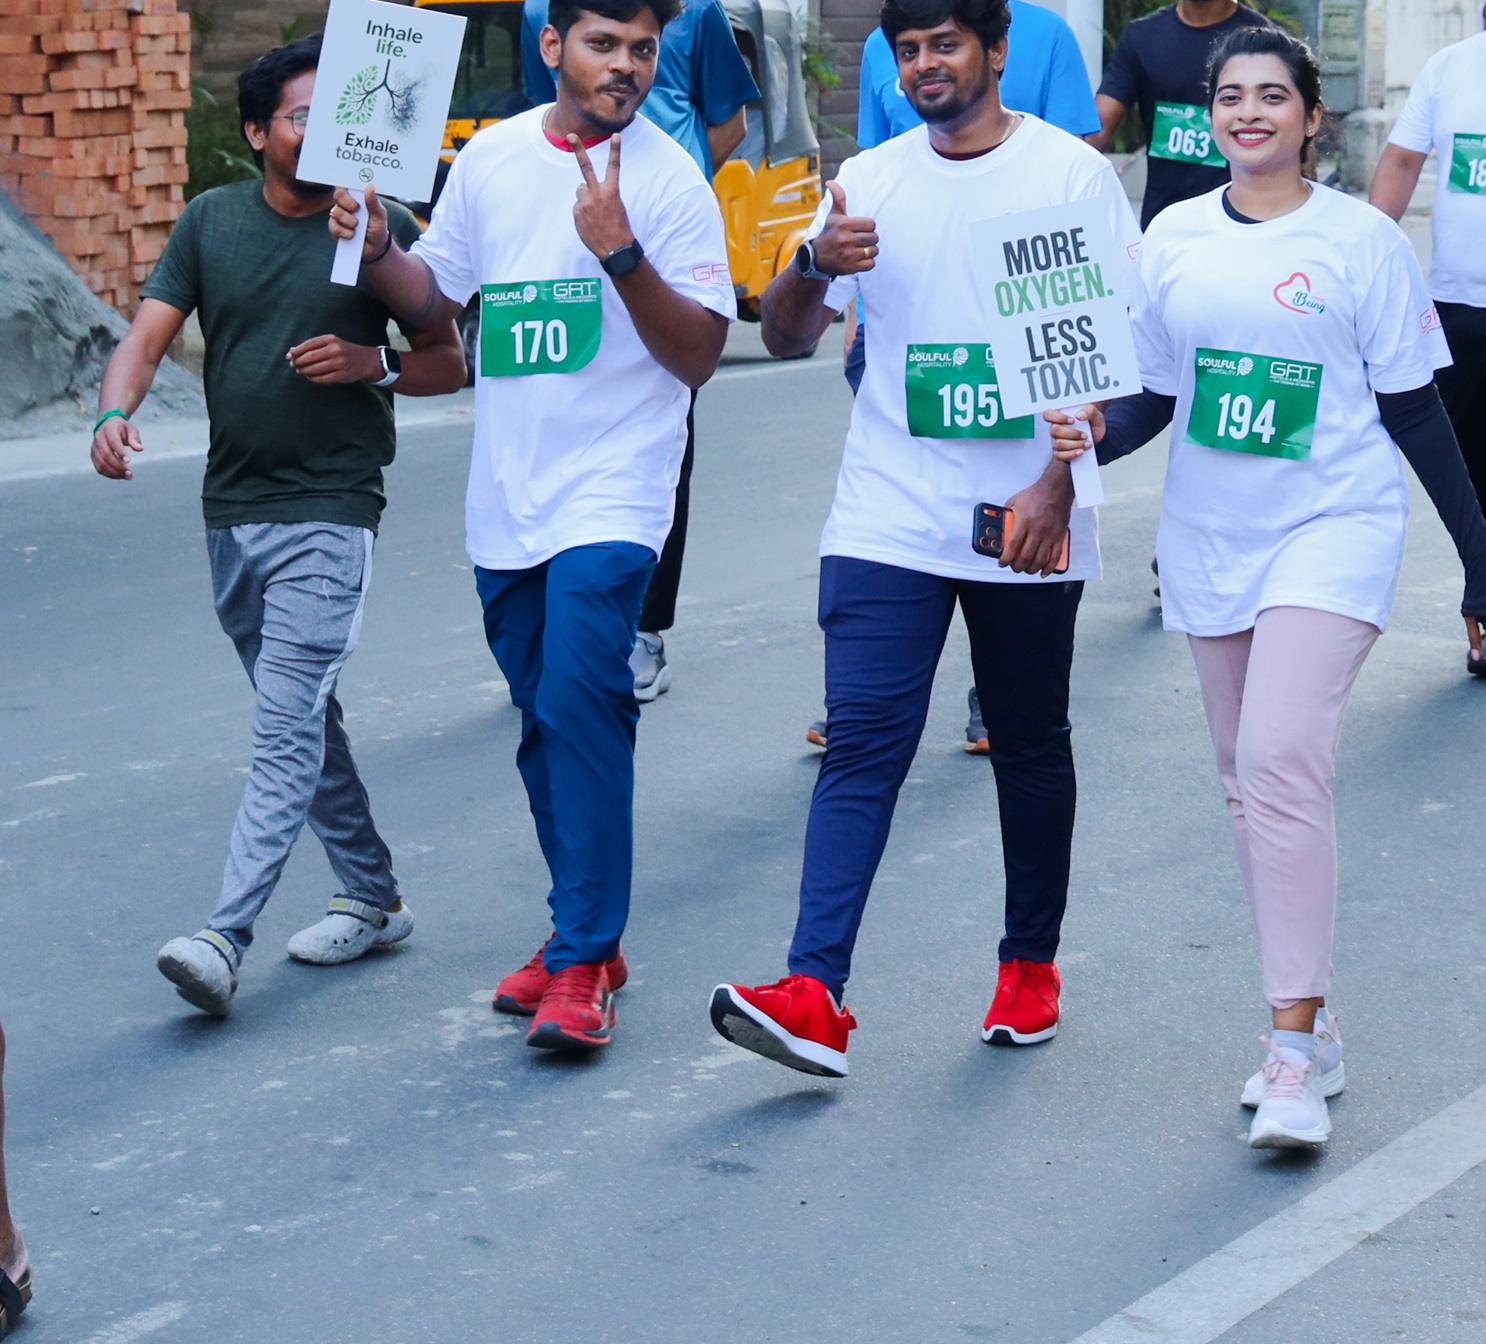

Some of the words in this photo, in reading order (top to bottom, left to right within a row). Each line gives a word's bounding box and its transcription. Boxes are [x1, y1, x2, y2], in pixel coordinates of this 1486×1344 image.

[366, 20, 423, 44] Inhale
[376, 38, 407, 58] life.
[344, 132, 399, 154] Exhale
[1168, 126, 1211, 158] 063
[336, 146, 404, 170] tobacco.
[1003, 227, 1089, 277] MORE
[484, 291, 522, 302] SOULFUL
[553, 282, 597, 297] GRT
[995, 263, 1114, 317] OXYGEN.
[1292, 290, 1326, 314] Being
[510, 319, 568, 364] 170
[1025, 315, 1097, 363] LESS
[909, 352, 952, 362] SOULFUL
[1197, 357, 1236, 369] SOULFUL
[1020, 353, 1120, 404] TOXIC.
[1206, 368, 1236, 376] HOSPITALITY
[1269, 361, 1317, 380] GRT
[938, 383, 998, 427] 195
[1217, 393, 1276, 444] 194
